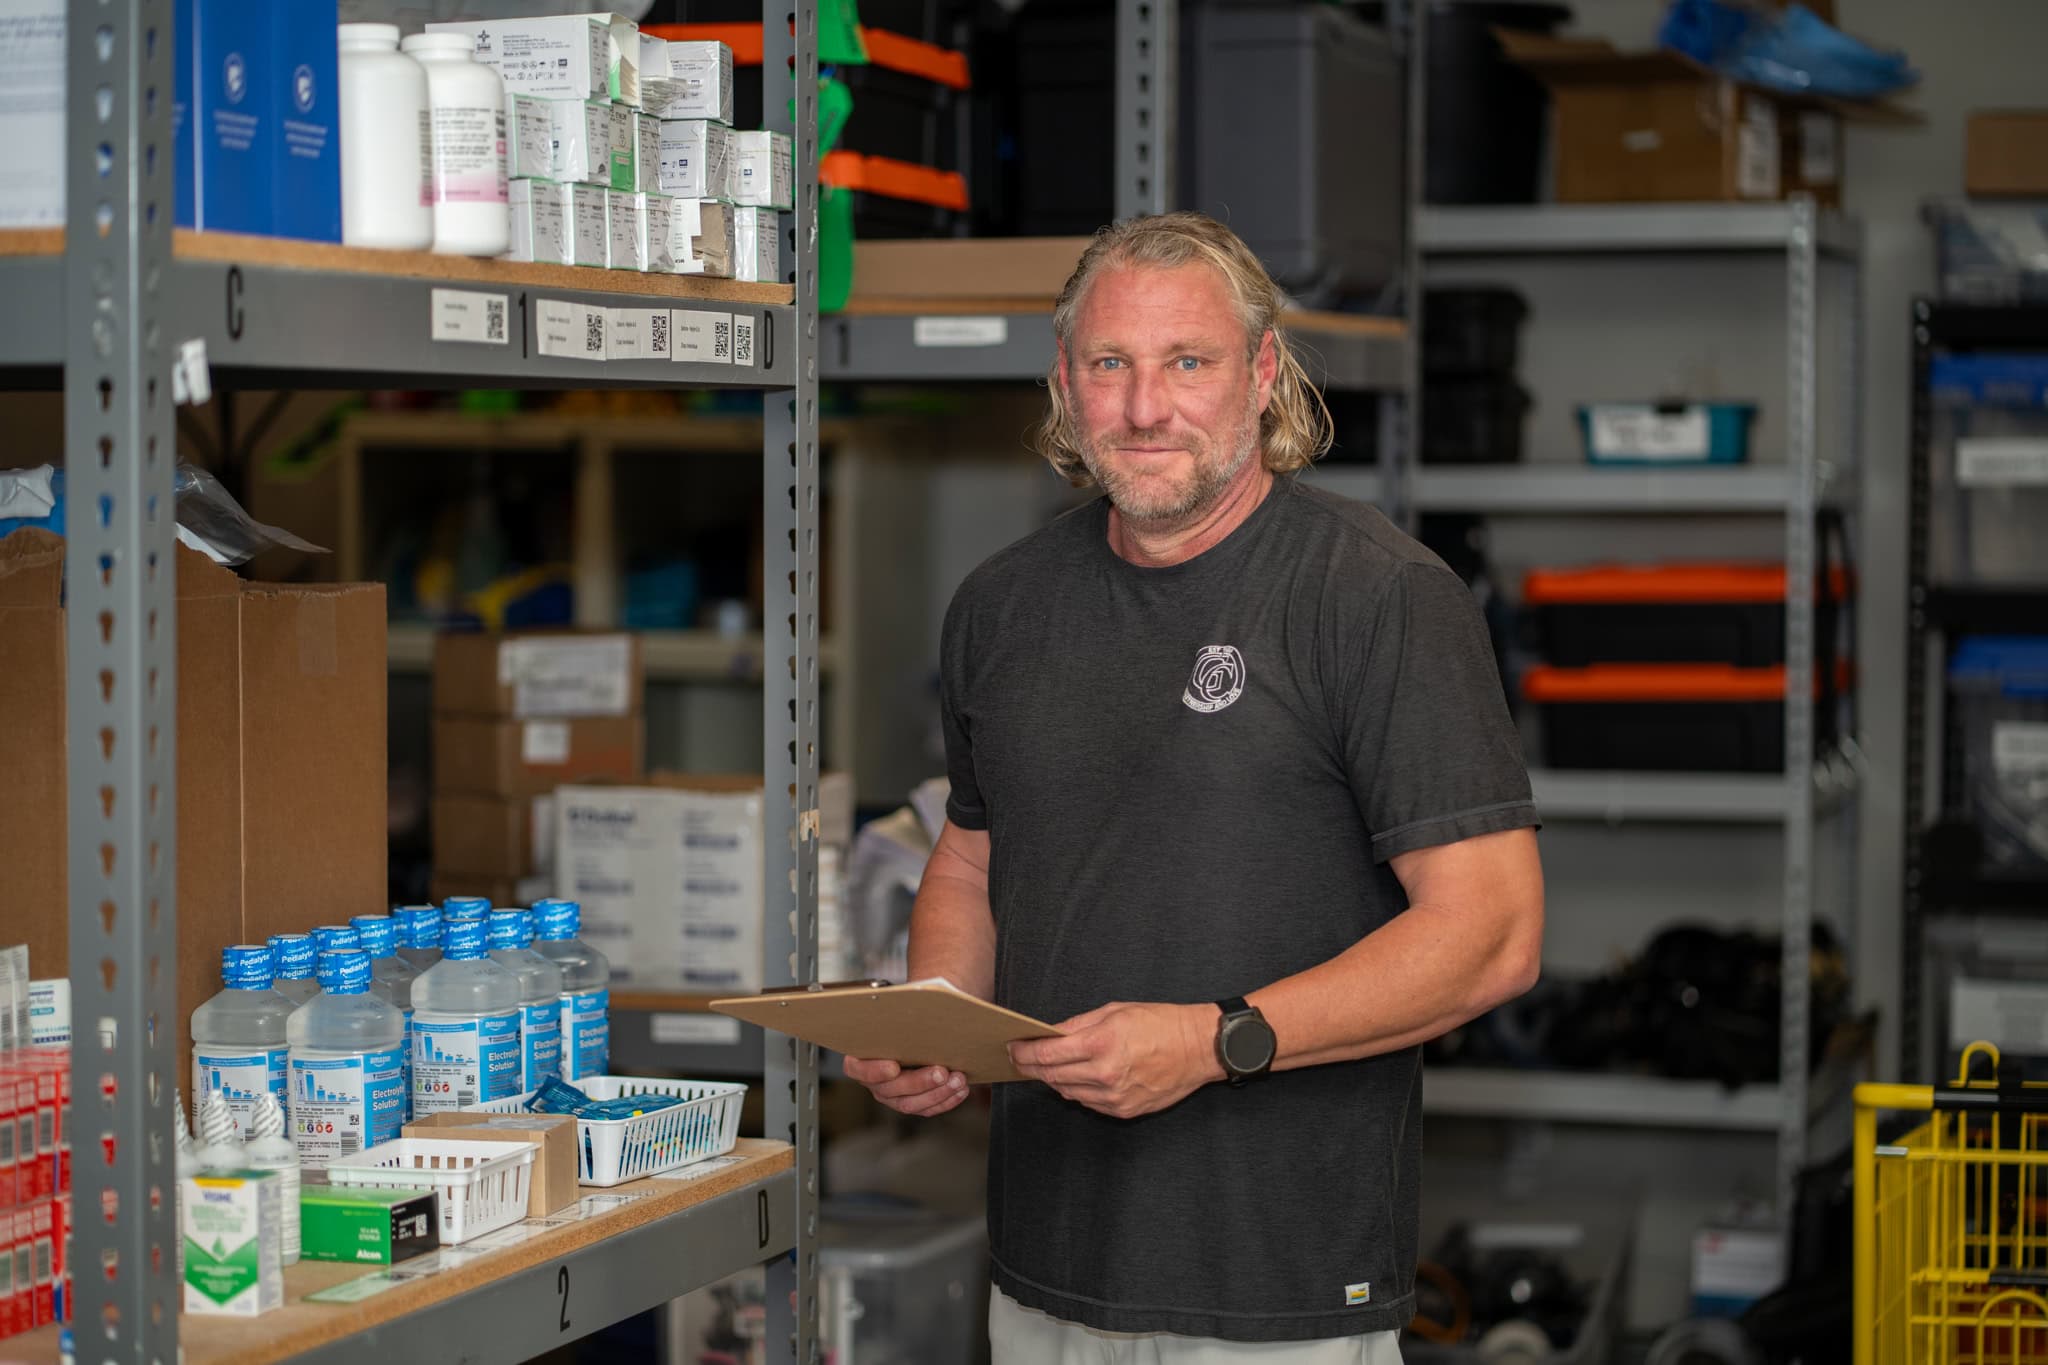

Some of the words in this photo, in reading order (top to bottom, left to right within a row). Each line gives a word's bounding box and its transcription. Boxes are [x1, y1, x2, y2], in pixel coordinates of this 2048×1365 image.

[225, 265, 244, 341] C
[518, 291, 527, 359] 1
[763, 310, 774, 370] D
[240, 954, 270, 966] Pedialyte
[282, 950, 314, 963] Pedialyte
[488, 1060, 516, 1073] Solution
[372, 1099, 400, 1111] Solution
[757, 1189, 769, 1249] D
[356, 1248, 382, 1260] Alcon
[557, 1265, 571, 1333] 2
